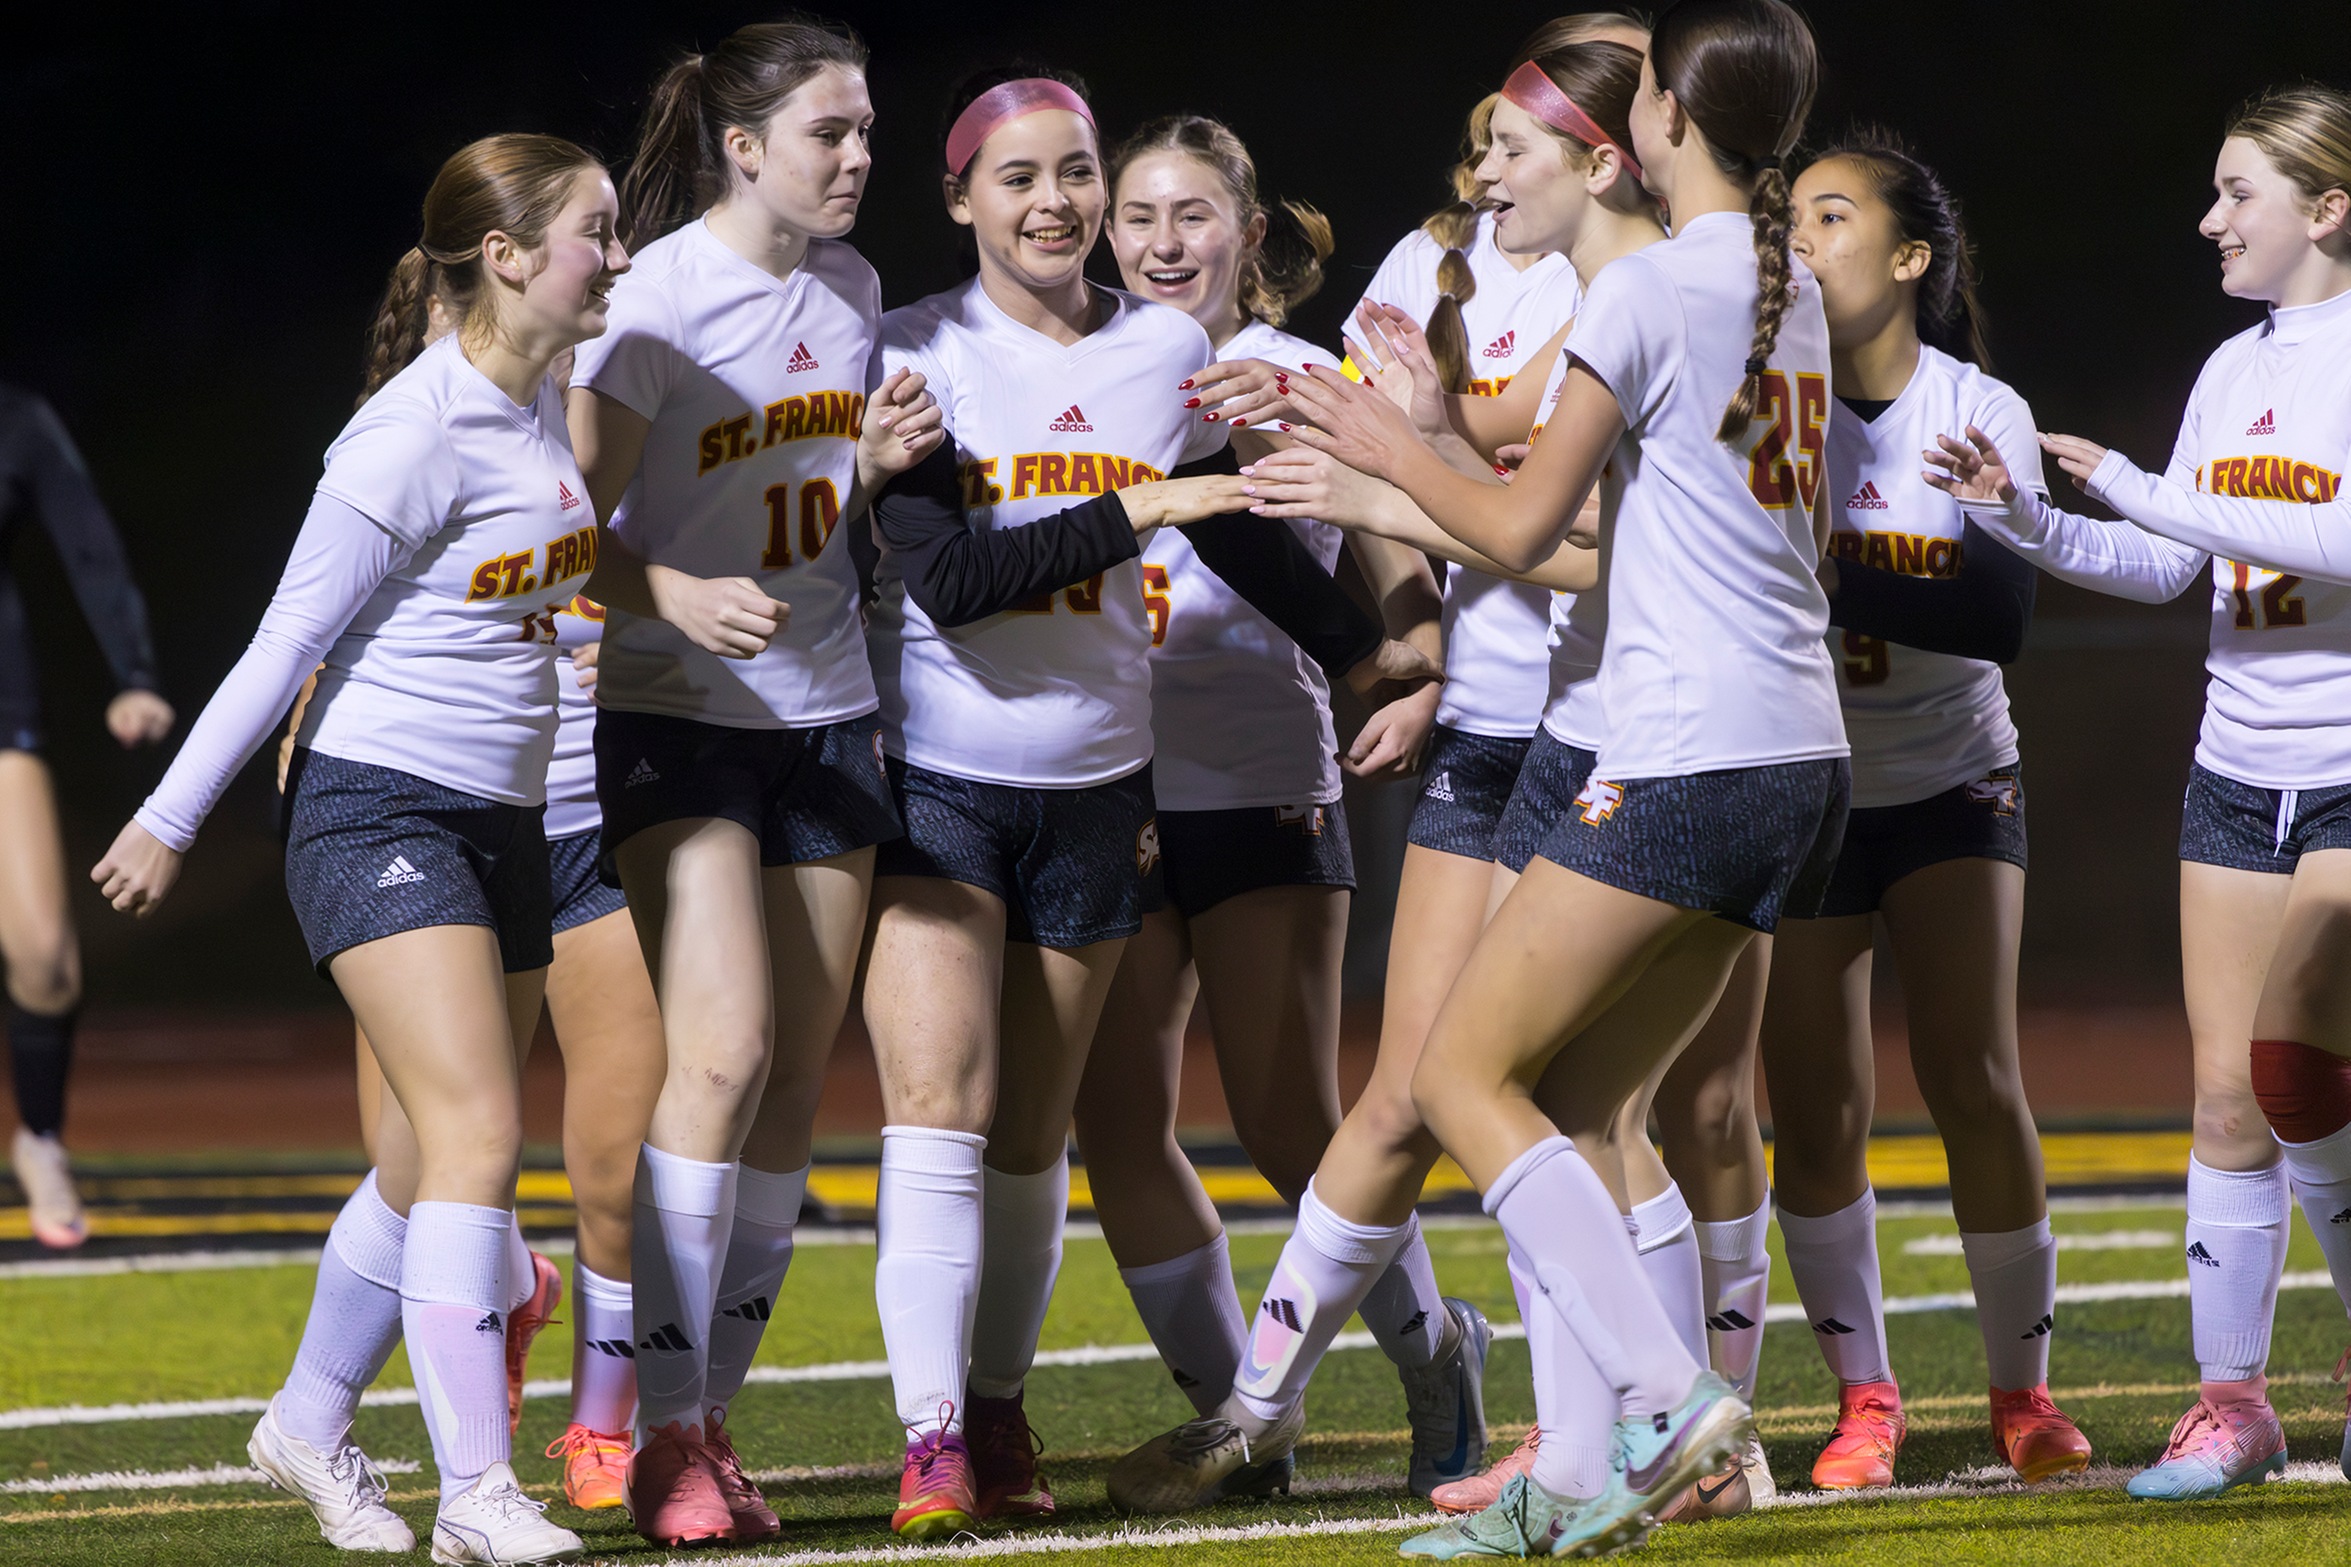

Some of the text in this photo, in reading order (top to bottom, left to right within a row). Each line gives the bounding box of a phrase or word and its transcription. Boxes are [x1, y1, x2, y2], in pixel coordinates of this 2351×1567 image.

[786, 360, 819, 374] adidas
[1049, 421, 1094, 433] adidas
[2246, 424, 2276, 436] adidas
[698, 413, 757, 477] ST.
[1748, 370, 1825, 512] 25
[560, 497, 580, 511] adidas
[1846, 498, 1888, 510] adidas
[761, 476, 841, 571] 10
[464, 547, 537, 604] ST.
[377, 871, 425, 888] adidas
